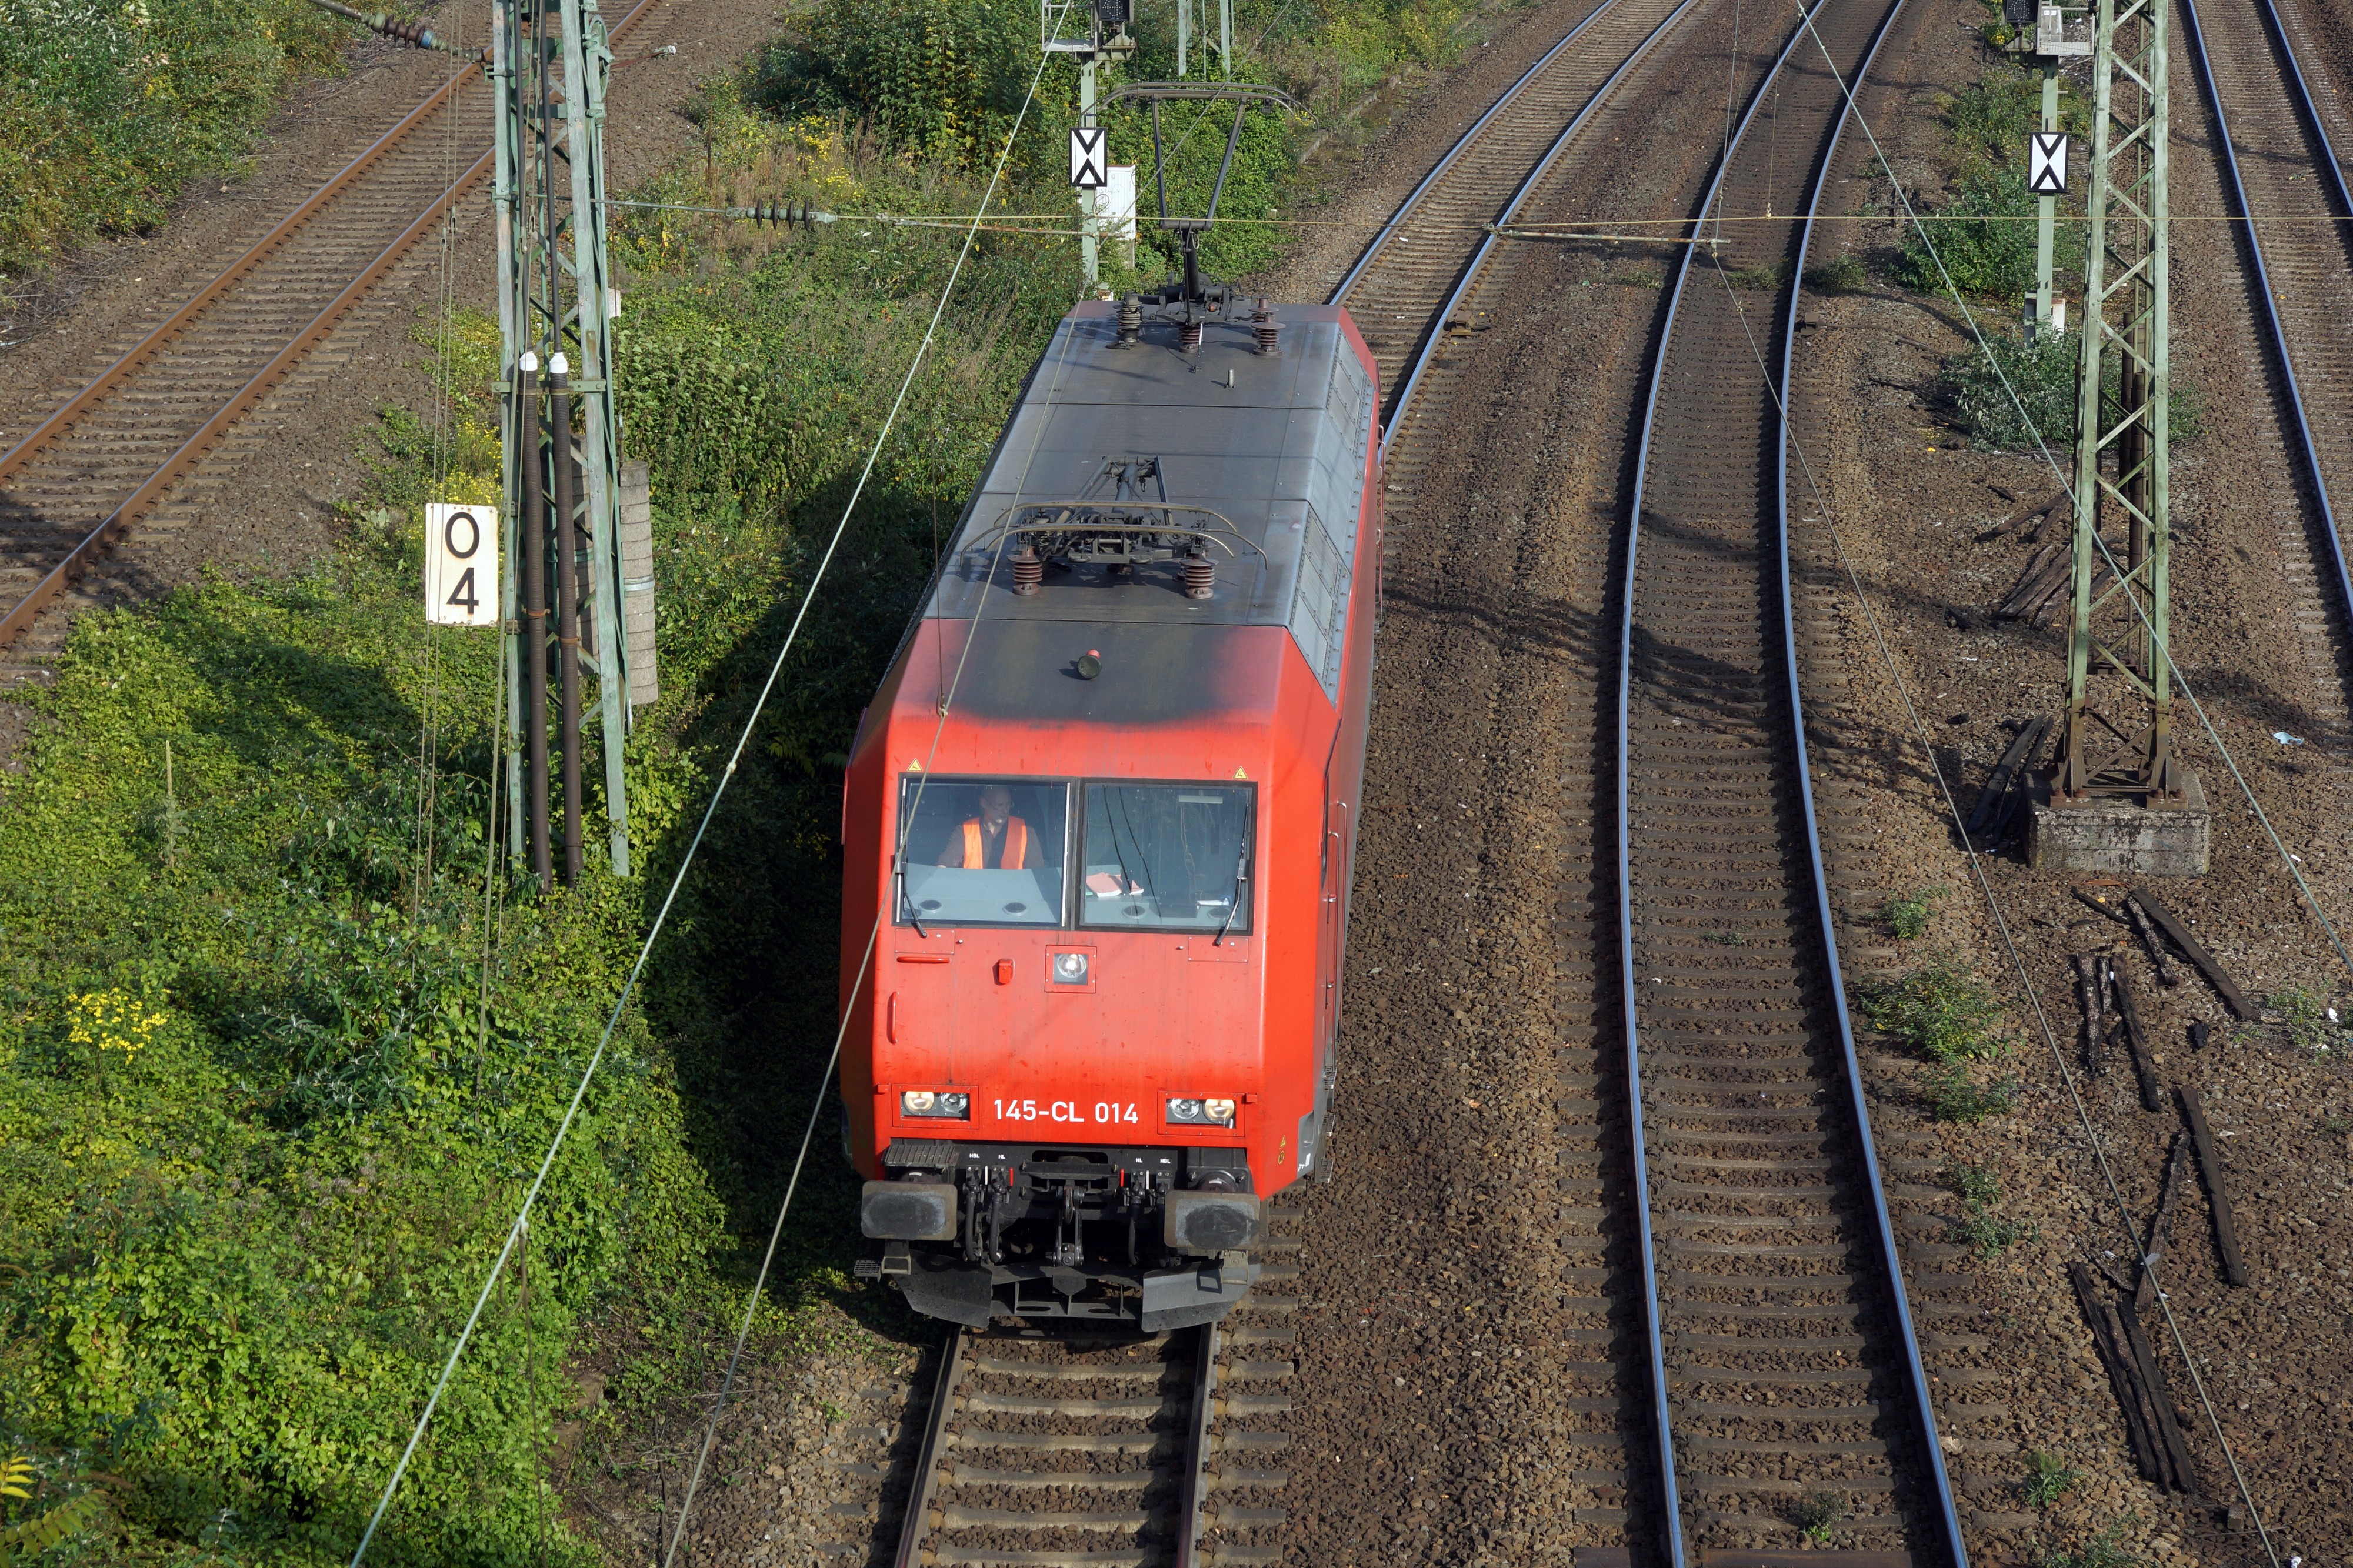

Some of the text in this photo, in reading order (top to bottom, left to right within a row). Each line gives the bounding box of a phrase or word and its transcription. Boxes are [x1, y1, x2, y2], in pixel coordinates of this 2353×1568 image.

[445, 512, 479, 559] 0
[446, 567, 479, 615] 4
[994, 1099, 1138, 1123] 145-CL 014
